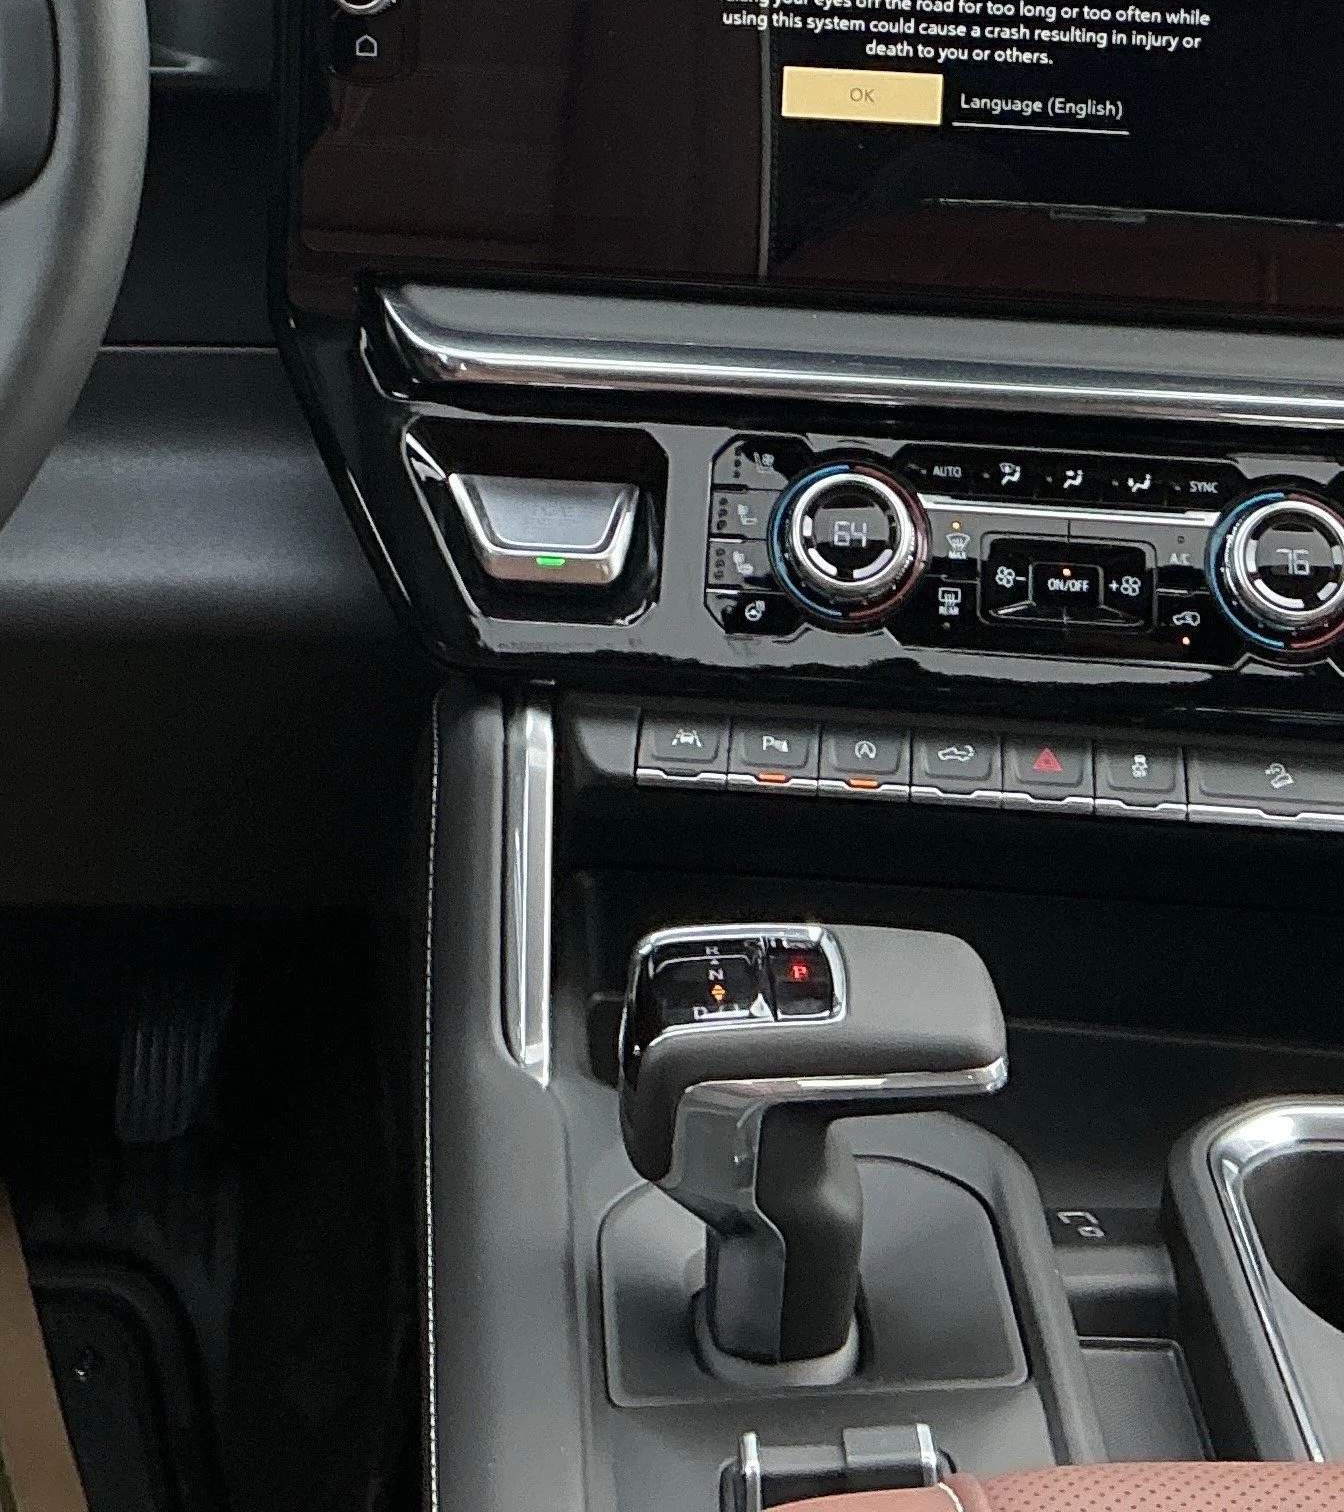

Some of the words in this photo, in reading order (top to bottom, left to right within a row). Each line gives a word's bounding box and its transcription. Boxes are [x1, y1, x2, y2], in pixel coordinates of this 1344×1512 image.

[987, 1, 1015, 16] too
[1019, 0, 1057, 22] long
[1061, 6, 1079, 19] or
[1083, 5, 1111, 21] too
[1115, 5, 1161, 23] often
[1166, 8, 1211, 26] while
[722, 11, 767, 31] using
[772, 10, 802, 28] this
[806, 16, 866, 34] system
[869, 17, 915, 34] could
[919, 24, 967, 37] cause
[971, 26, 980, 37] a
[985, 23, 1030, 40] crash
[1034, 26, 1107, 48] resulting
[1112, 29, 1127, 45] in
[1131, 30, 1179, 52] injury
[1182, 36, 1202, 49] or
[865, 39, 913, 58] death
[917, 44, 935, 59] to
[937, 47, 968, 63] you
[972, 48, 991, 61] or
[994, 46, 1053, 64] others.
[849, 87, 875, 103] OK
[960, 93, 1043, 116] Language
[1047, 97, 1123, 120] (English)
[932, 465, 962, 478] AUTO
[1189, 480, 1219, 494] SYNC
[833, 520, 868, 548] 64
[1047, 578, 1090, 593] ON/OFF
[709, 967, 725, 981] N
[792, 964, 808, 980] P
